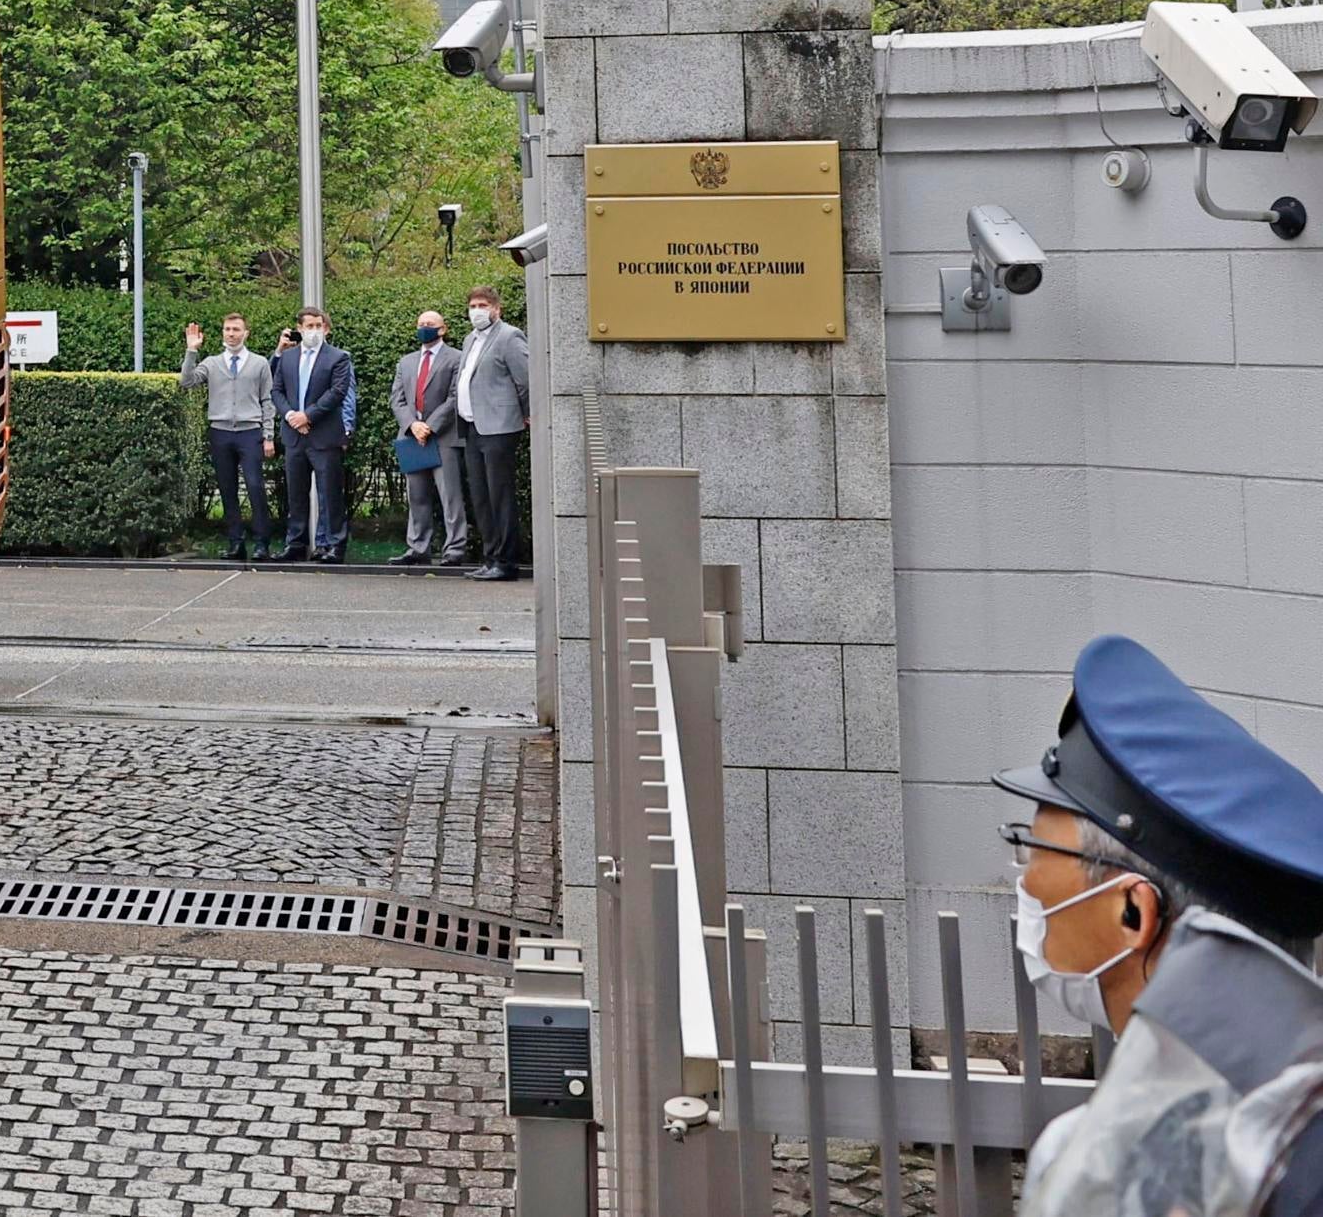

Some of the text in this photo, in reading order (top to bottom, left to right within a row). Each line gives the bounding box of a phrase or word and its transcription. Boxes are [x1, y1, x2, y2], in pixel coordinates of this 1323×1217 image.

[666, 242, 759, 256] ПОСОЛЬСТВО
[617, 259, 805, 275] РОССИЙСКОЙ ФЕДЕРАЦИИ
[674, 281, 750, 294] В ЯПОНИИ
